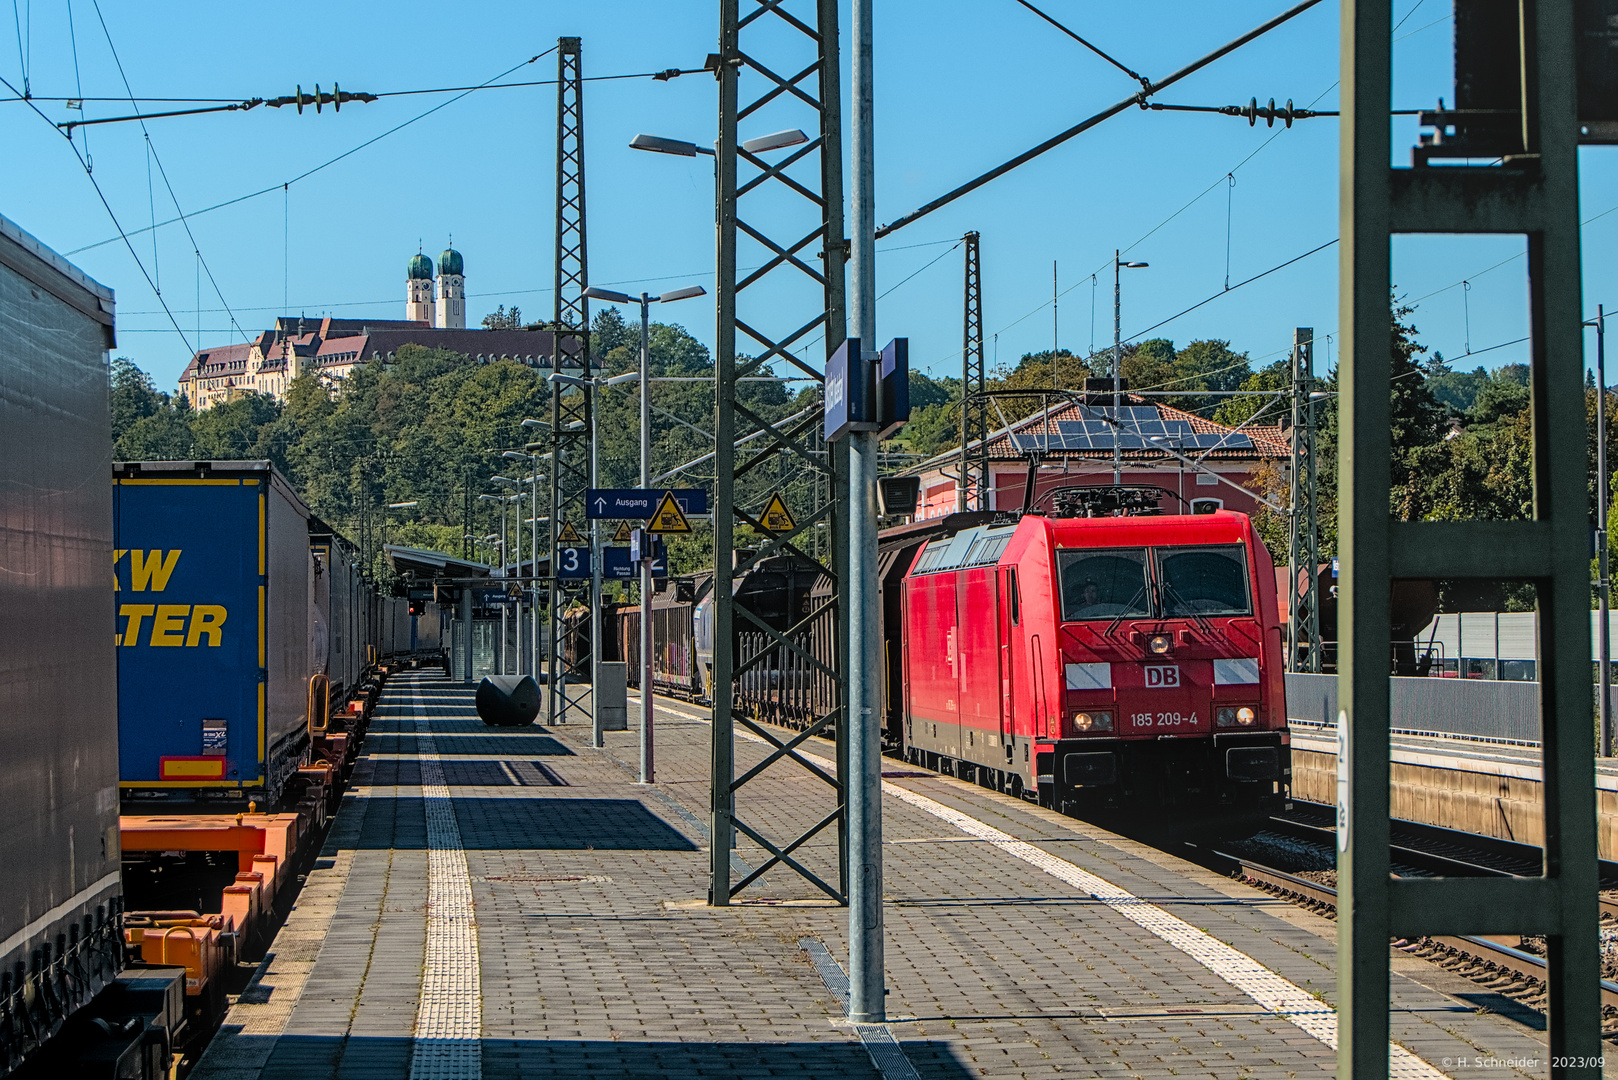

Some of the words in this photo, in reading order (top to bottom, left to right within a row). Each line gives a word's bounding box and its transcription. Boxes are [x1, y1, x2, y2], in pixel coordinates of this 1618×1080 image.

[615, 498, 648, 508] Ausgang
[563, 548, 579, 571] 3
[115, 604, 228, 647] TER
[1146, 667, 1178, 686] DB
[1131, 713, 1153, 727] 185
[1157, 711, 1198, 726] 209-4
